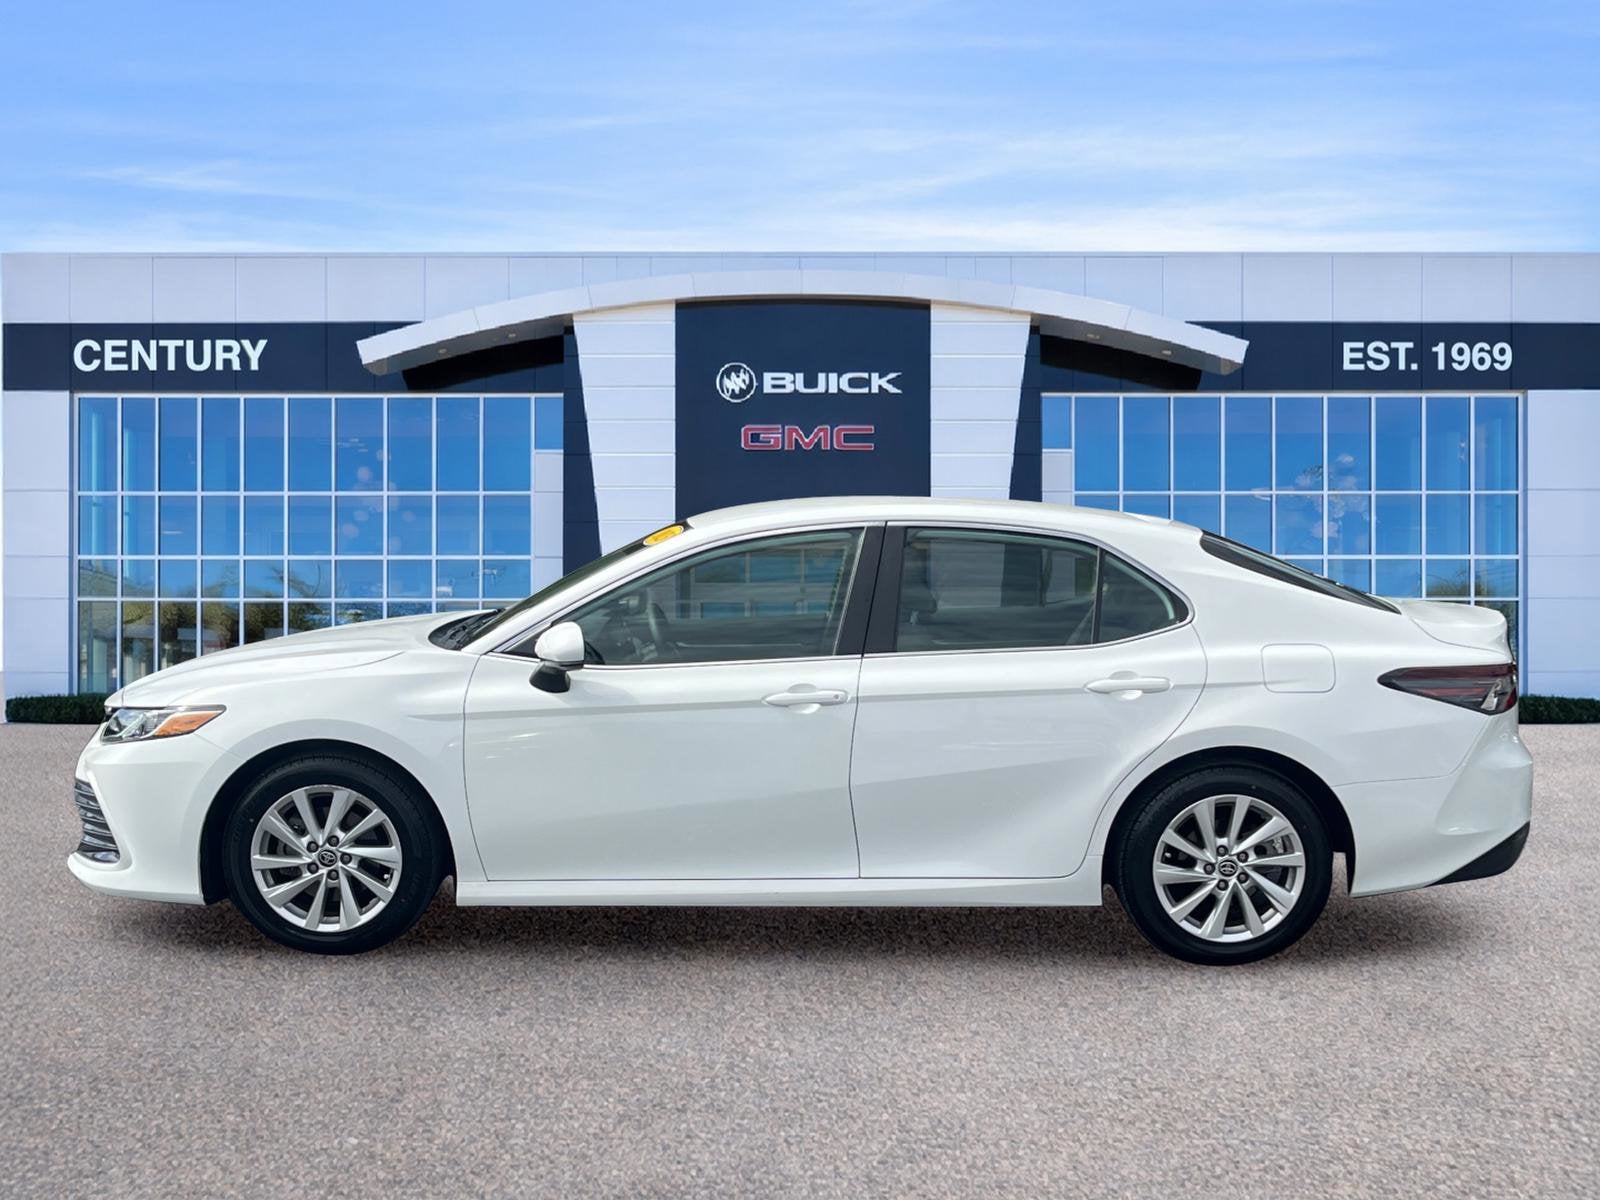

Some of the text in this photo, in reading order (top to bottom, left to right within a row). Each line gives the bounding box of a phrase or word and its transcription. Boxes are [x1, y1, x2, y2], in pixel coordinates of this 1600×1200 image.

[73, 339, 268, 372] CENTURY
[1342, 341, 1513, 371] EST. 1969
[762, 371, 903, 394] BUICK
[741, 424, 875, 451] GMC
